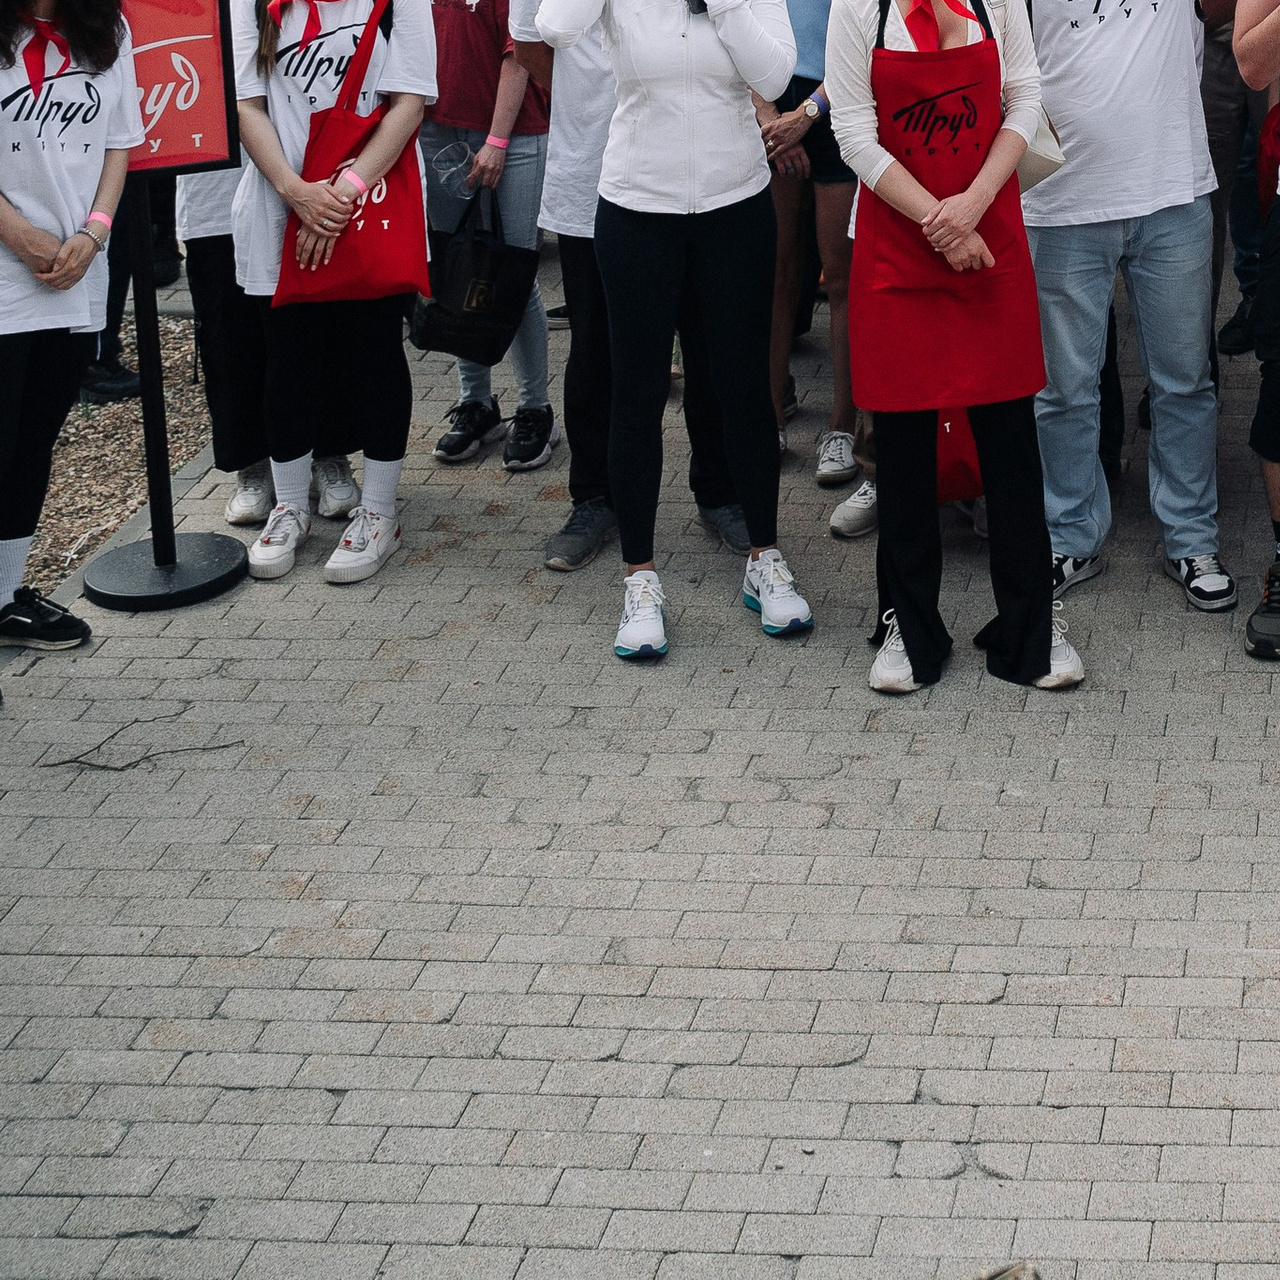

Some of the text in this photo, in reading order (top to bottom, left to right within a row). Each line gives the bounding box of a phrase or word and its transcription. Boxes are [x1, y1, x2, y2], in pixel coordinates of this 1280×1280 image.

[1070, 2, 1159, 29] КРУТ
[275, 22, 368, 94] Тру
[892, 81, 983, 147] Труд
